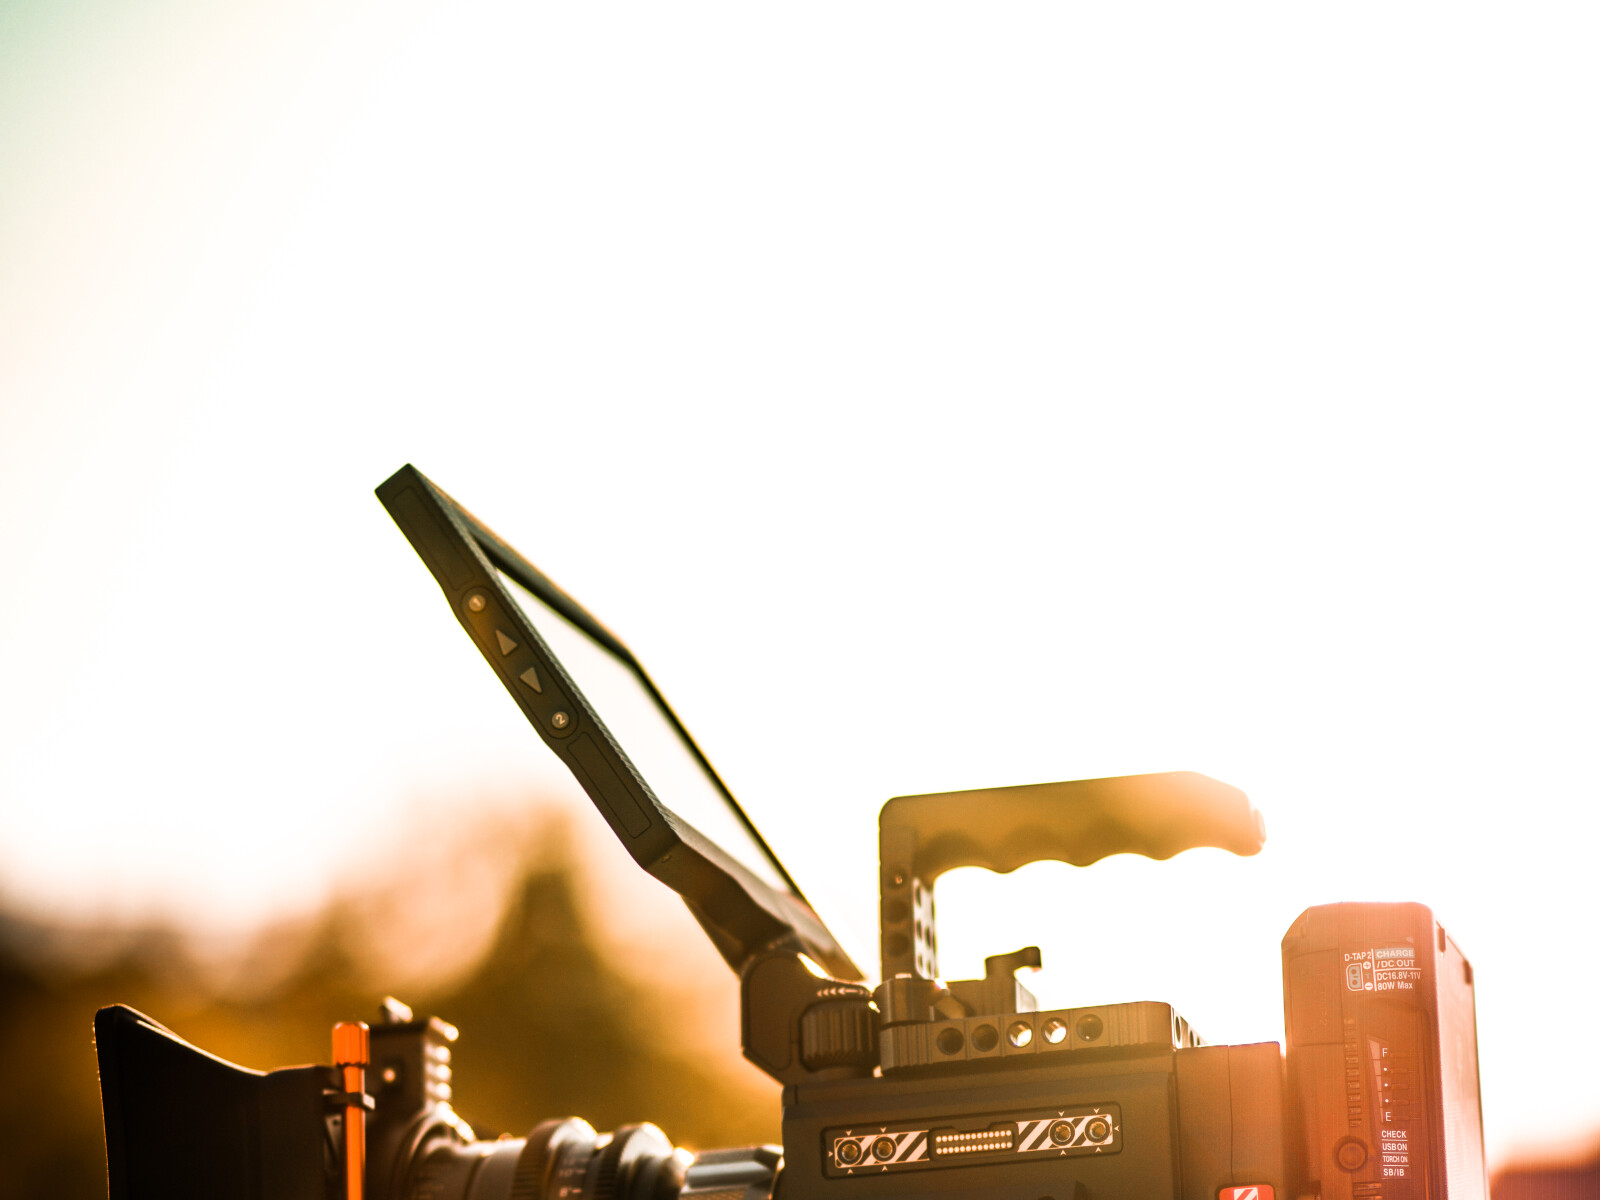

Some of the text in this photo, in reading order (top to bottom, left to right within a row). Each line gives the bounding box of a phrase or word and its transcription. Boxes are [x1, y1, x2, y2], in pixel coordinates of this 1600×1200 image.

[555, 714, 566, 725] 2
[1344, 952, 1366, 961] D-TAP
[1376, 949, 1414, 958] CHARGE
[1396, 960, 1415, 968] OUT
[1378, 981, 1413, 991] 80W Max
[1382, 1047, 1388, 1058] F
[1385, 1111, 1392, 1122] E
[1381, 1130, 1407, 1138] CHECK
[1382, 1142, 1408, 1151] USB ON
[1382, 1155, 1408, 1163] TORCH ON
